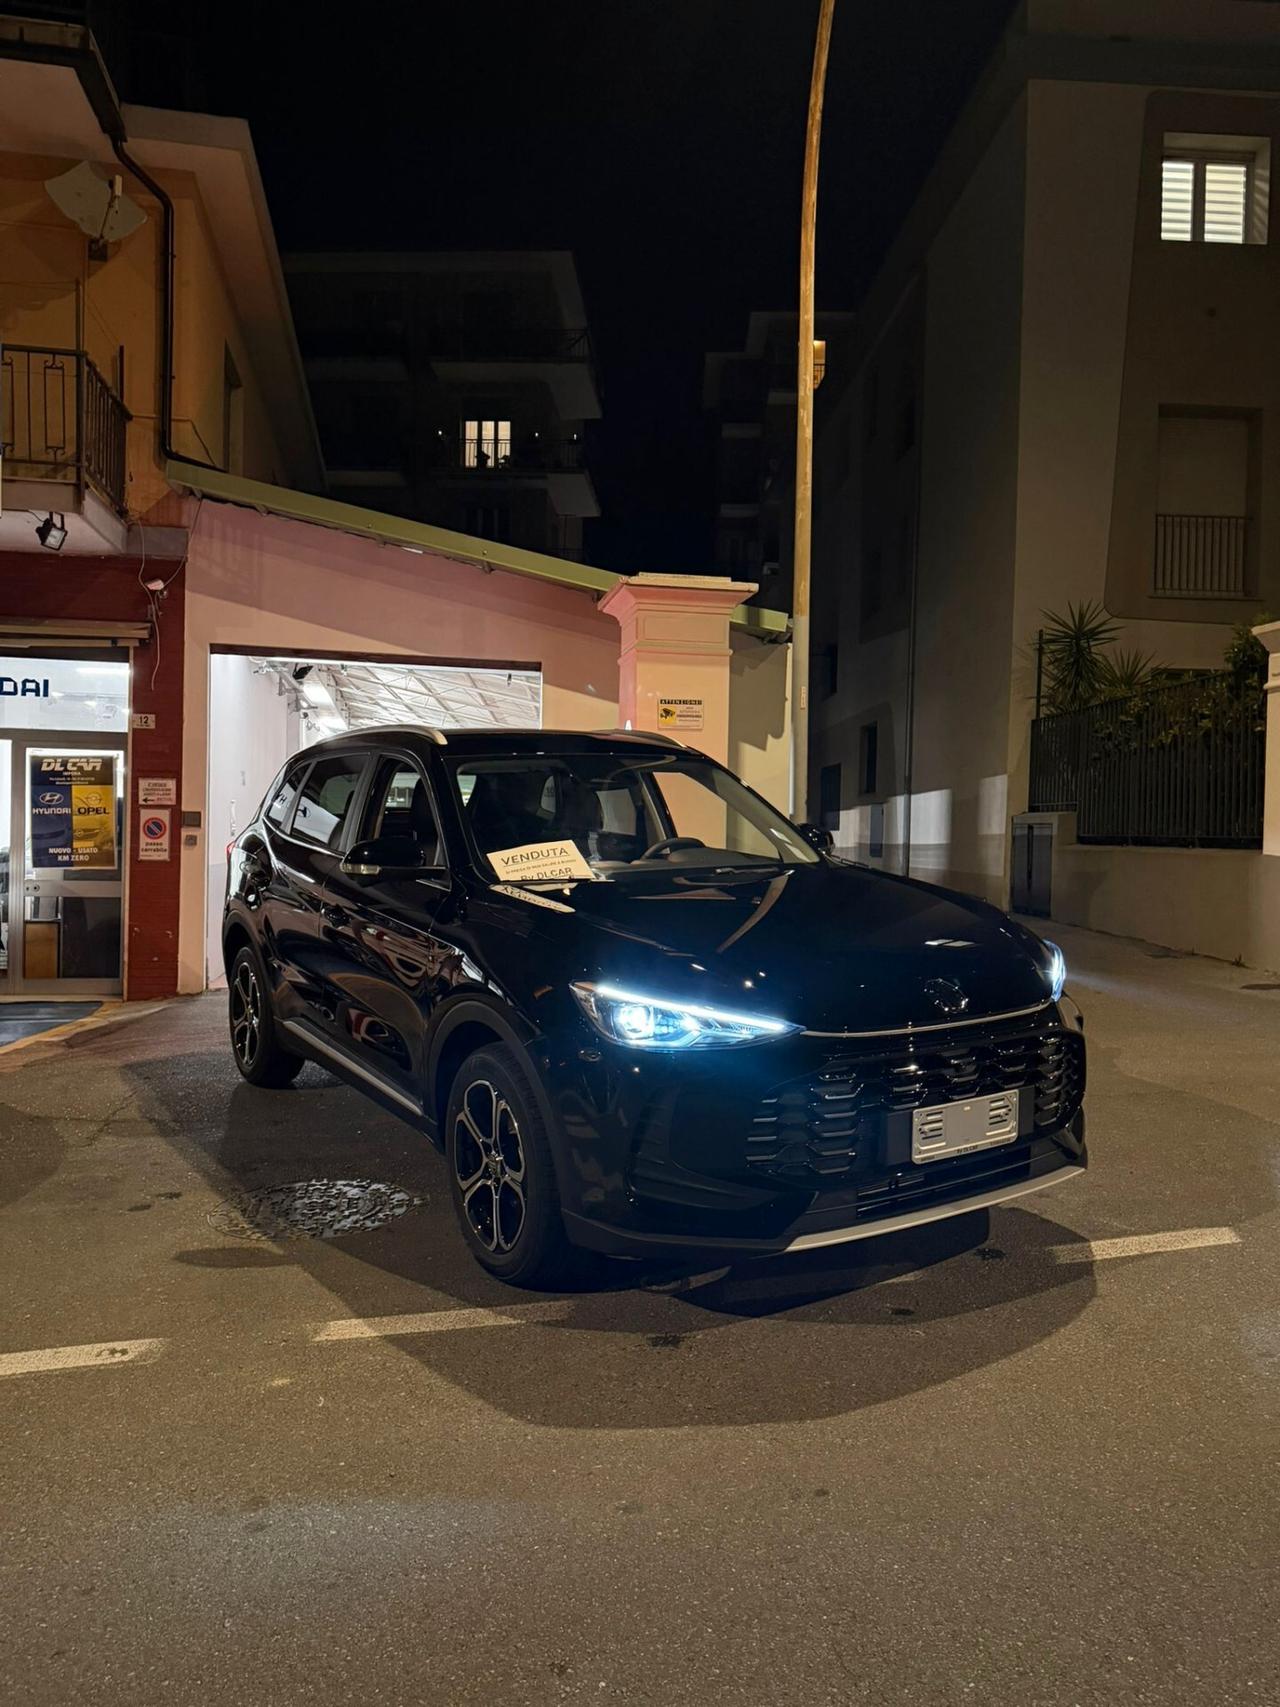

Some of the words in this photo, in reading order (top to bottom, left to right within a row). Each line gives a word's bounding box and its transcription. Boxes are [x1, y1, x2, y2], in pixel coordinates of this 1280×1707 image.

[0, 677, 49, 697] DAI
[139, 715, 149, 724] 12
[32, 807, 71, 815] HYUNDAI
[77, 806, 110, 815] OPEL
[57, 854, 69, 862] KM
[70, 854, 89, 862] ZERO
[501, 848, 568, 865] VENDUTA
